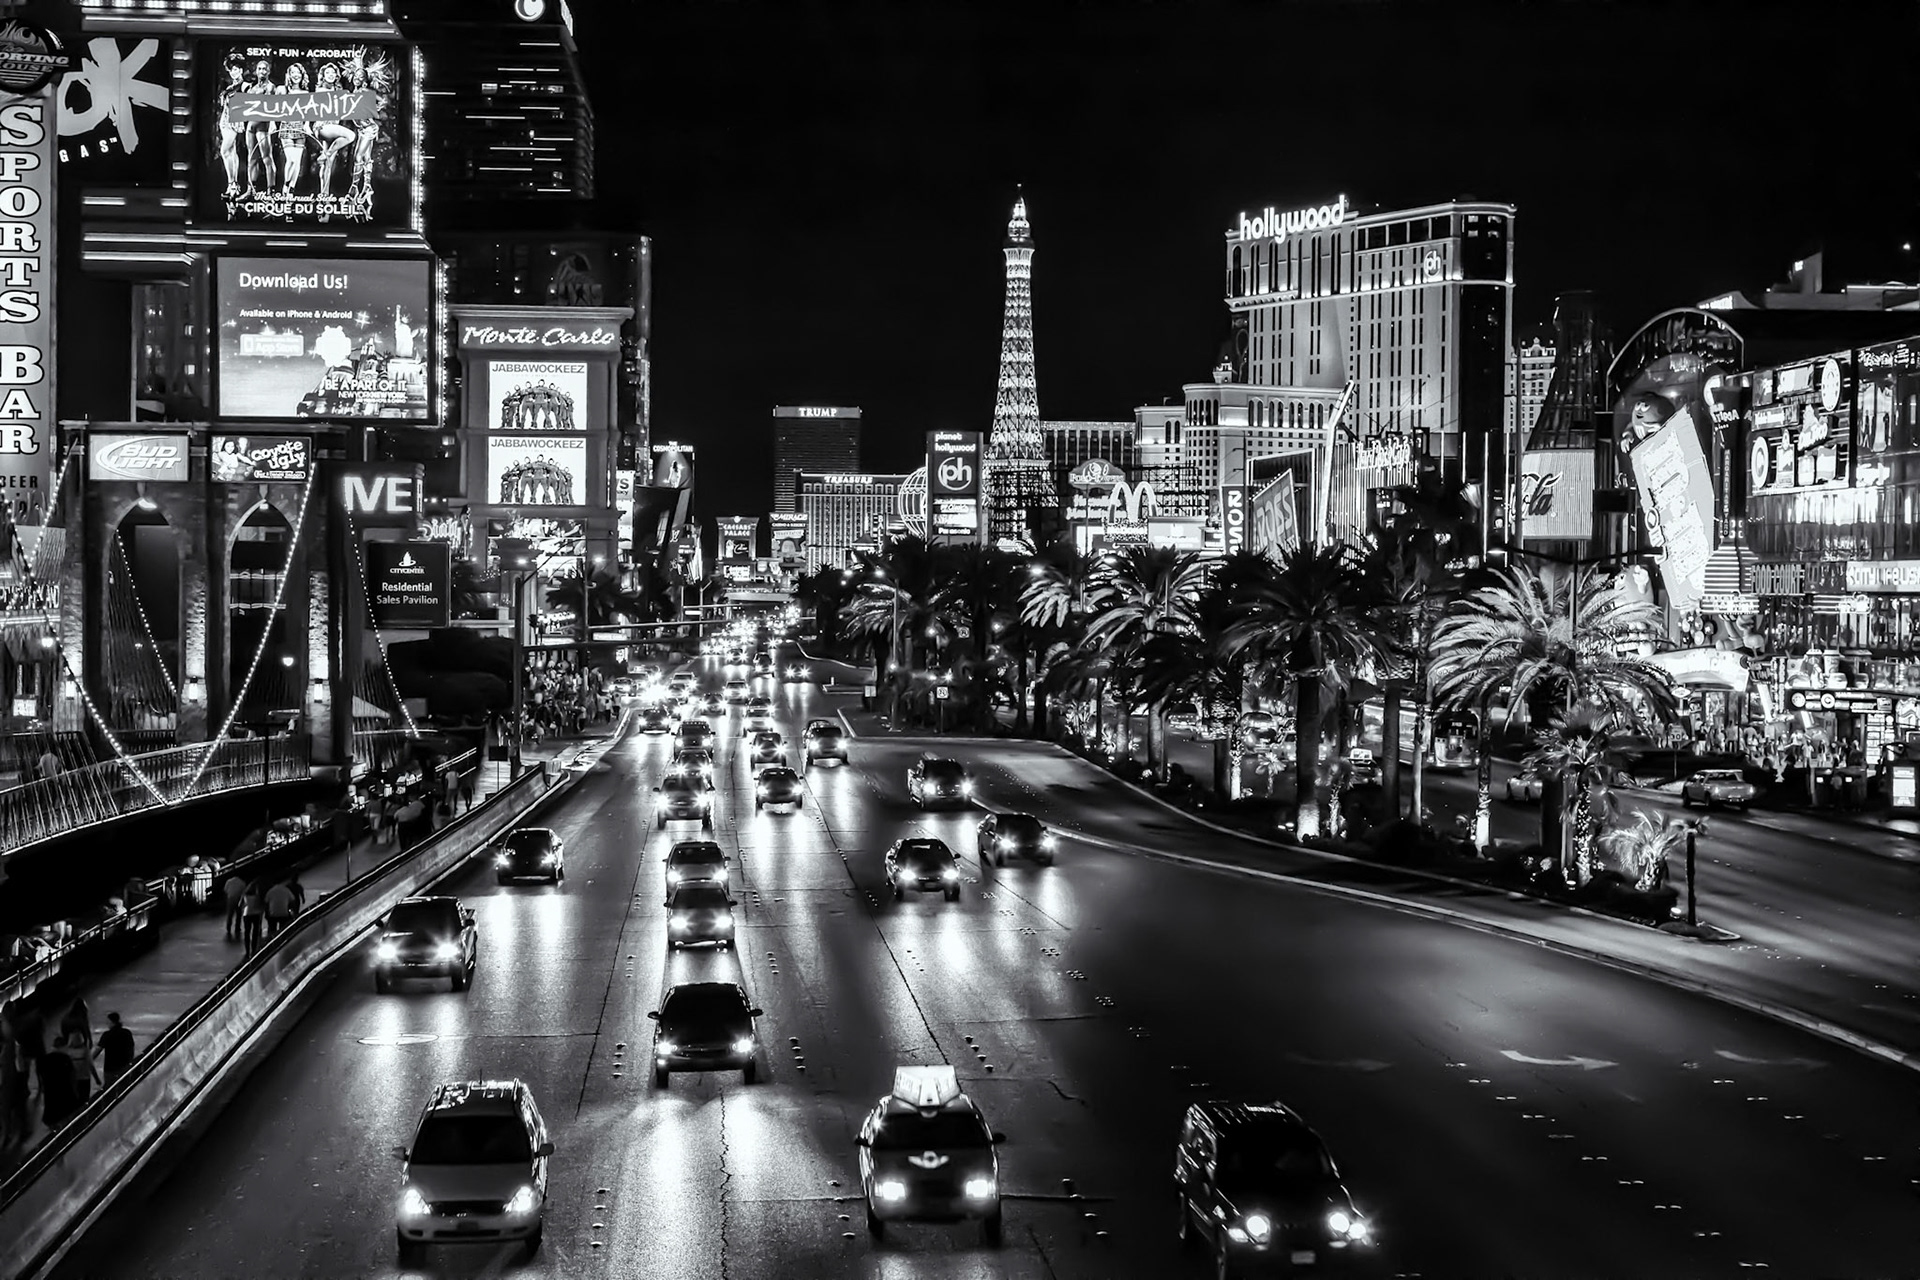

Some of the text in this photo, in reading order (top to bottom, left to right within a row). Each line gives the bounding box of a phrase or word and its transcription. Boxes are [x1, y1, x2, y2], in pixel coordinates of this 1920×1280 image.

[246, 47, 272, 57] SEXY
[279, 48, 299, 58] FUN
[0, 62, 54, 73] OUSE
[244, 202, 292, 216] CIRQUE
[295, 203, 314, 214] DU
[1239, 194, 1345, 244] hollywood
[239, 272, 348, 289] Download Us!
[240, 309, 274, 318] Available
[287, 310, 313, 319] iPhone
[314, 310, 321, 319] &
[322, 310, 353, 319] Android
[462, 326, 615, 346] Monte Carlo
[492, 363, 585, 374] JABBAWOCKEEZ
[325, 380, 339, 391] BE
[340, 380, 350, 391] A
[351, 380, 378, 391] PART
[379, 380, 395, 391] OF
[799, 407, 837, 417] TRUMP
[935, 431, 963, 442] planet
[491, 438, 584, 449] JABBAWOCKEEZ
[935, 443, 976, 454] hollywood
[120, 444, 178, 457] BUD
[251, 440, 304, 462] coyote
[112, 457, 182, 470] LIGHT
[267, 450, 306, 470] ugly
[824, 476, 873, 484] TREASURE
[1751, 564, 1772, 595] FOOD
[382, 582, 433, 592] Residential
[376, 595, 438, 604] Sales Pavilion
